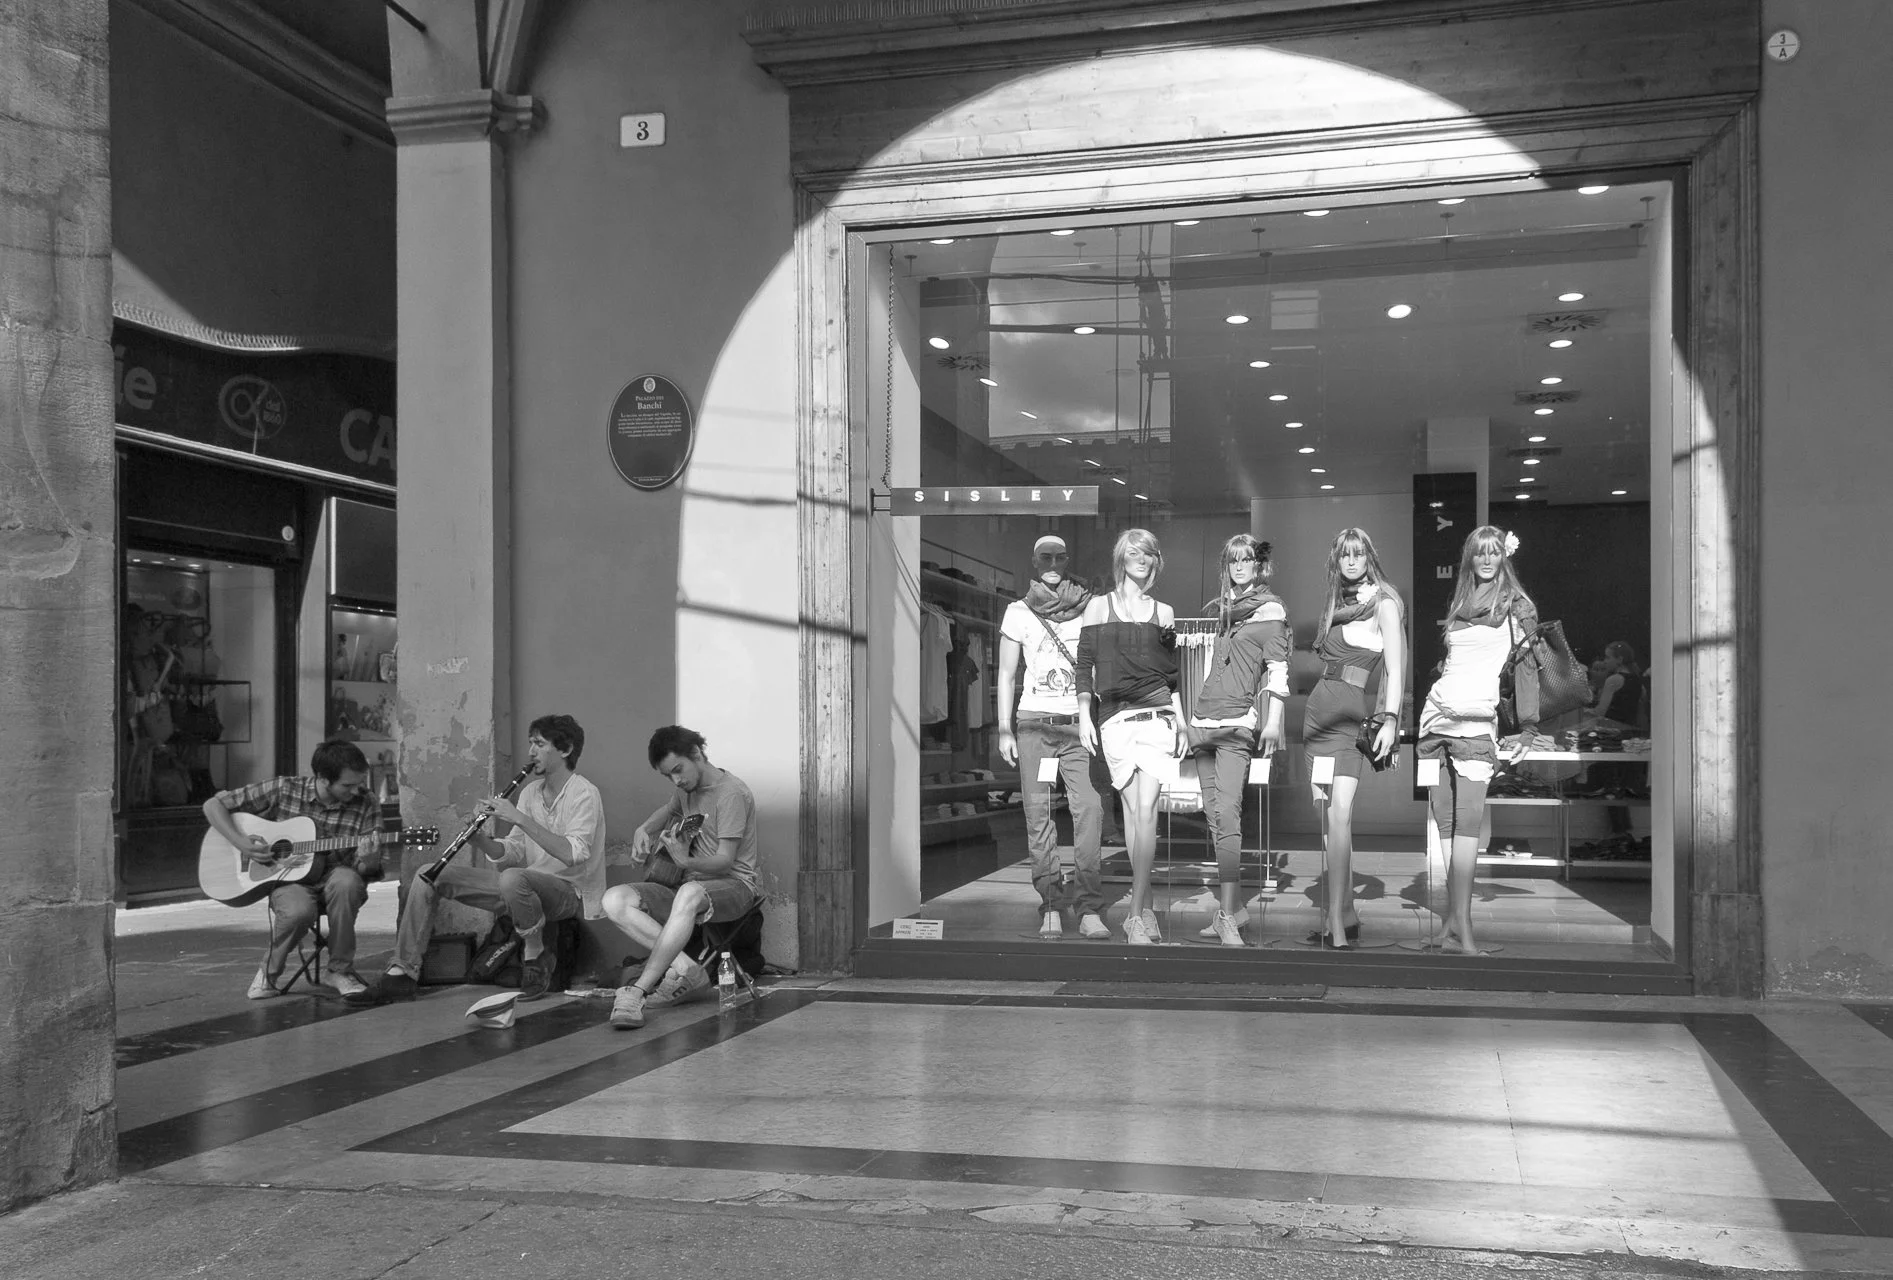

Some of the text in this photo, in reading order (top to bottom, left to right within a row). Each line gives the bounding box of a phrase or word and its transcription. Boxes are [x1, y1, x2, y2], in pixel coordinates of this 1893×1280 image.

[1780, 33, 1786, 45] 3
[1779, 47, 1788, 58] A
[637, 121, 649, 141] 3
[637, 401, 662, 410] Banchi
[914, 489, 1074, 502] SISLEY
